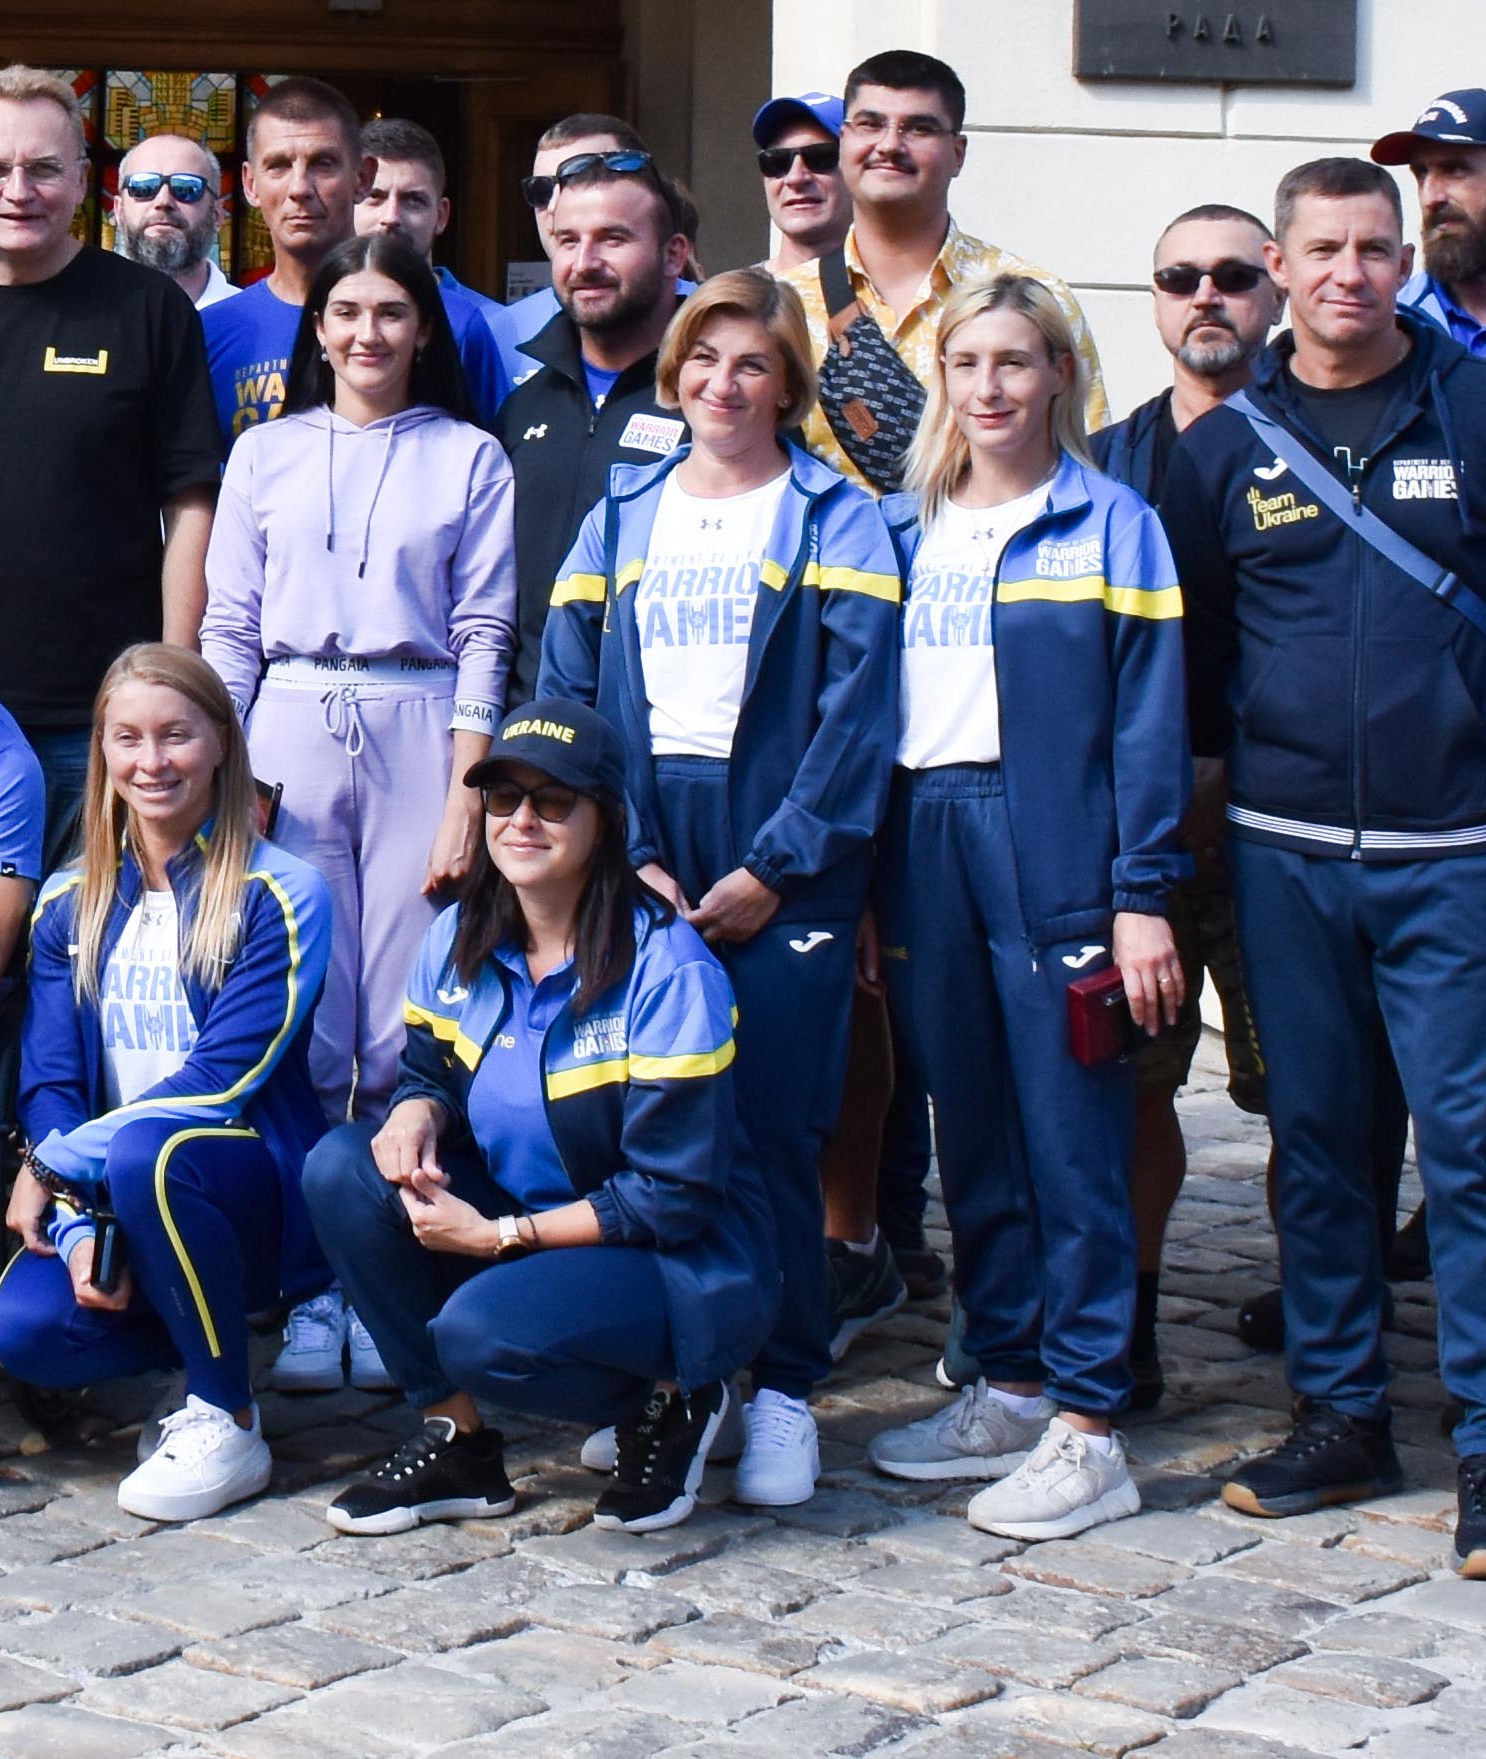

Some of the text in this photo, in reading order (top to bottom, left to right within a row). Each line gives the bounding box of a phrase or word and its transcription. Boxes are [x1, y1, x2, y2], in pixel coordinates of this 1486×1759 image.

[1166, 13, 1272, 41] РАДА
[53, 357, 99, 367] UNBROKEN
[235, 358, 289, 379] DEPARTM
[630, 419, 679, 438] WARRIOR
[623, 431, 674, 453] GAMES
[1393, 465, 1455, 481] WARRIO
[1250, 491, 1295, 514] Team
[1254, 503, 1319, 531] Ukraine
[1037, 539, 1102, 562] WARRIOR
[1035, 552, 1103, 578] GAMES
[640, 561, 760, 599] ARRIO
[643, 598, 750, 648] AME
[314, 657, 370, 672] PANGAIA
[454, 701, 493, 724] ANGAIA
[502, 719, 575, 744] UKRAINE
